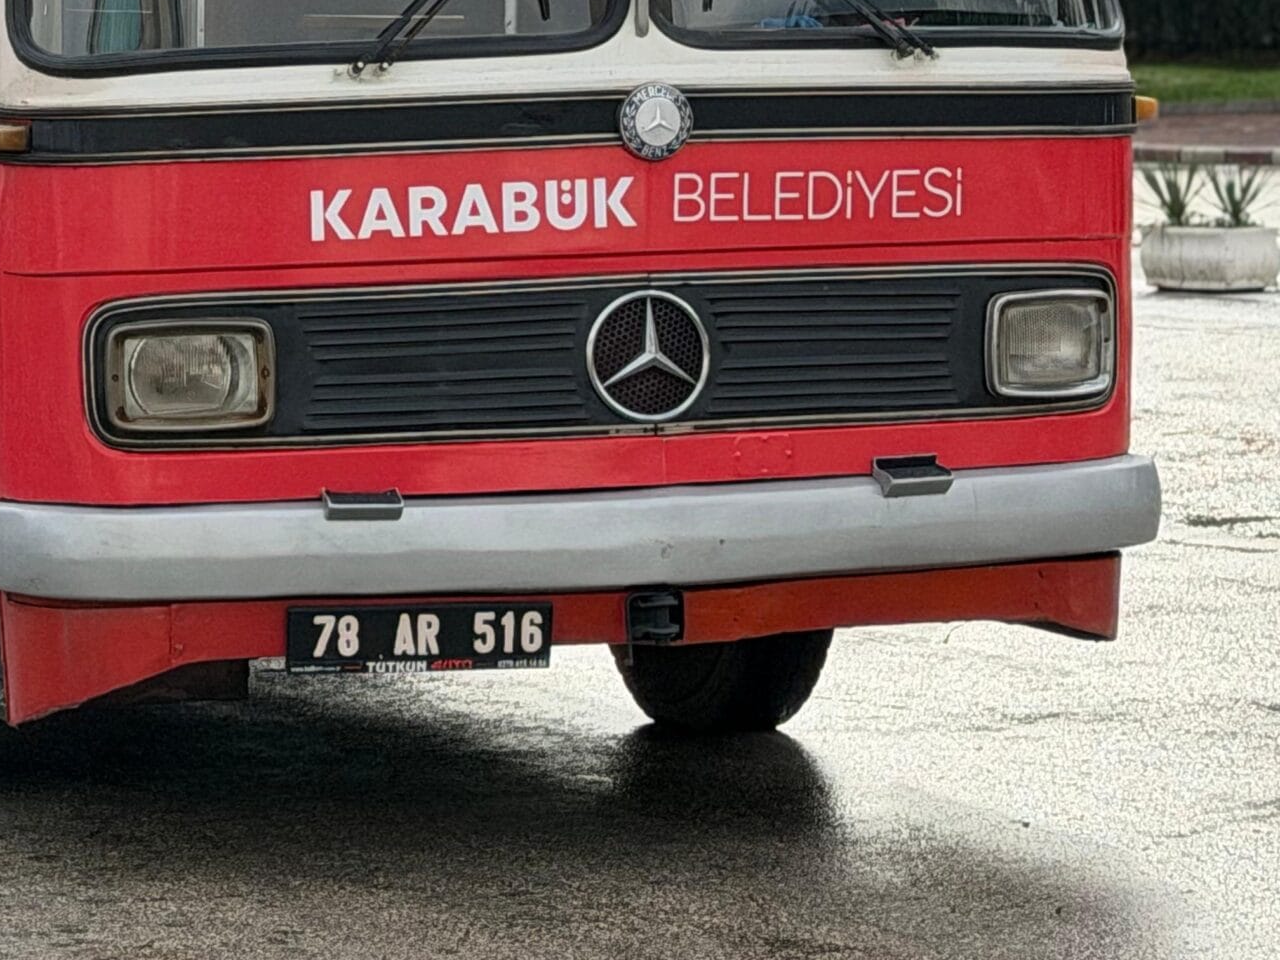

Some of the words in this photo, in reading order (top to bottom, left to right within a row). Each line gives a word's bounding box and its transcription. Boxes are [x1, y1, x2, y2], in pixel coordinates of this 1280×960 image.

[641, 145, 669, 158] BENZ
[309, 175, 637, 241] KARABÜK
[312, 614, 360, 658] 78
[393, 613, 440, 656] AR
[473, 611, 543, 654] 516
